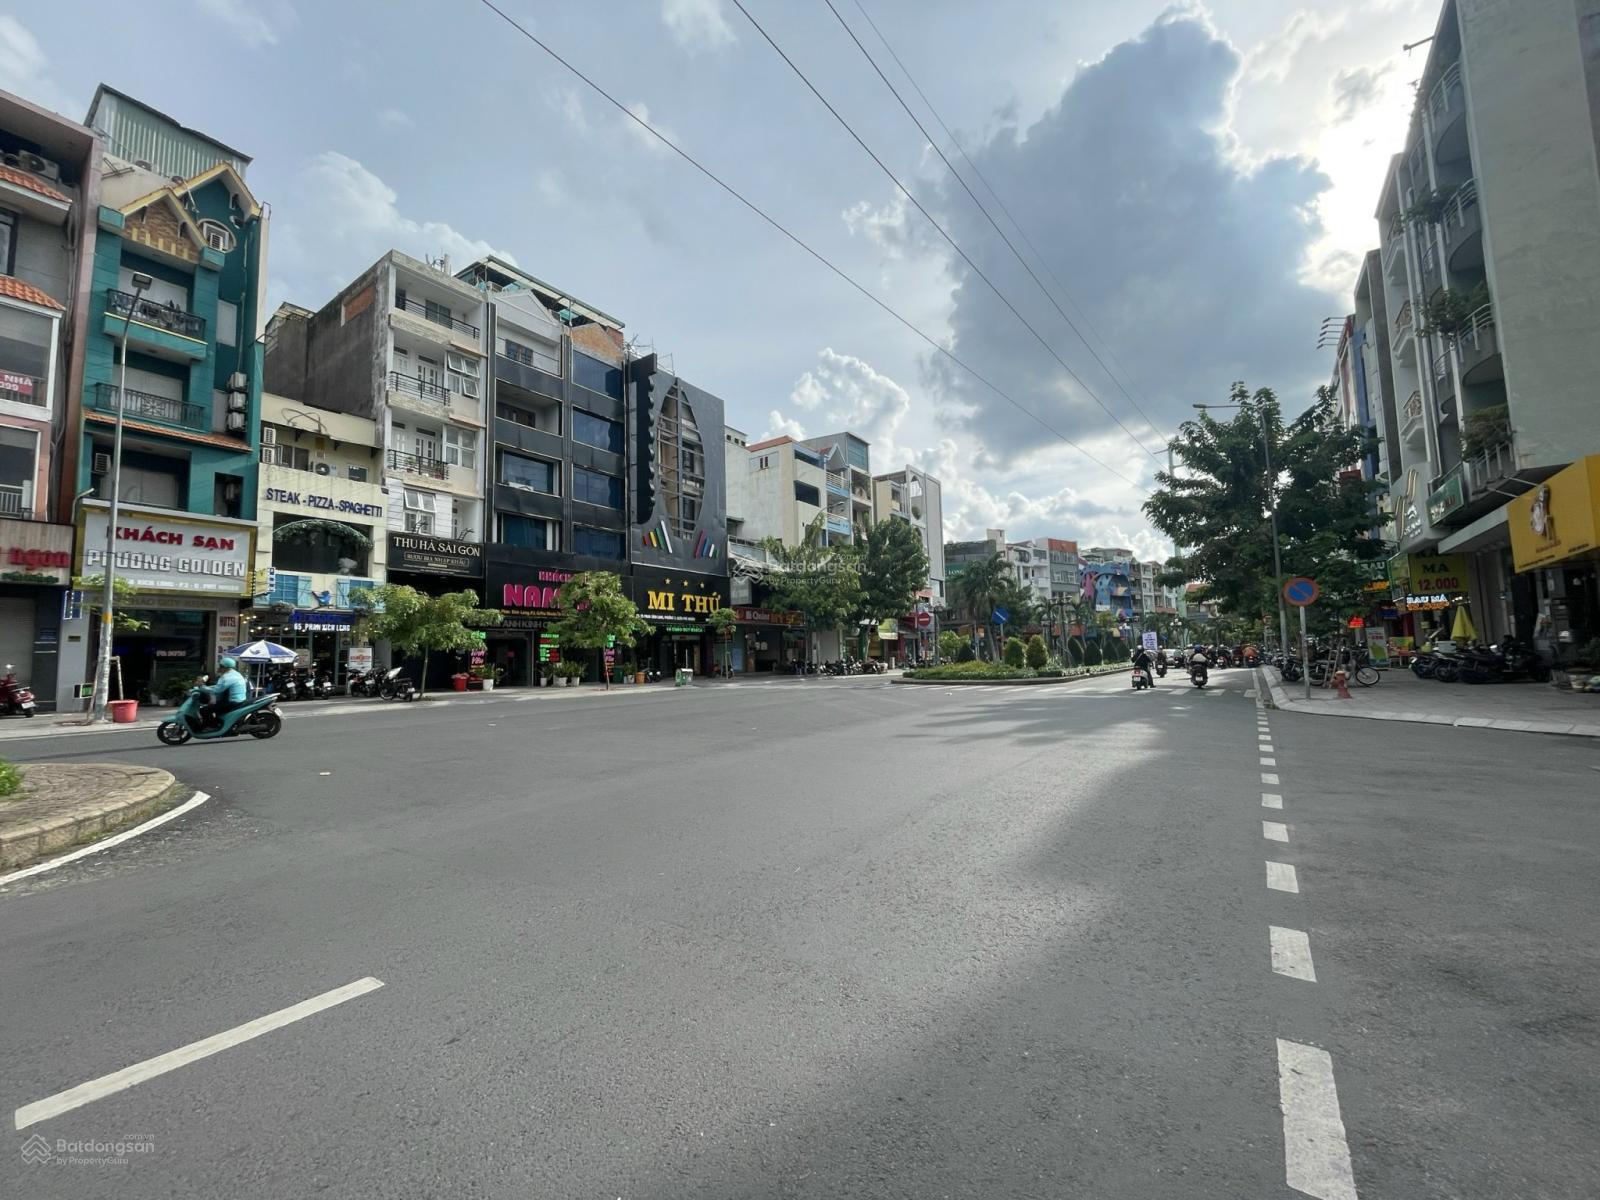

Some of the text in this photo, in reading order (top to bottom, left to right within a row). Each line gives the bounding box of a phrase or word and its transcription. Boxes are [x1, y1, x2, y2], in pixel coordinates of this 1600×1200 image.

[266, 488, 383, 517] STEAK PIZZA SPAGHETTI
[193, 535, 234, 550] SẠN
[393, 536, 480, 557] THU HÀ SÀI GÒN
[177, 557, 245, 576] GOLDEN
[1418, 577, 1459, 590] 12.000
[647, 590, 675, 611] MI
[219, 616, 236, 627] HOTEL
